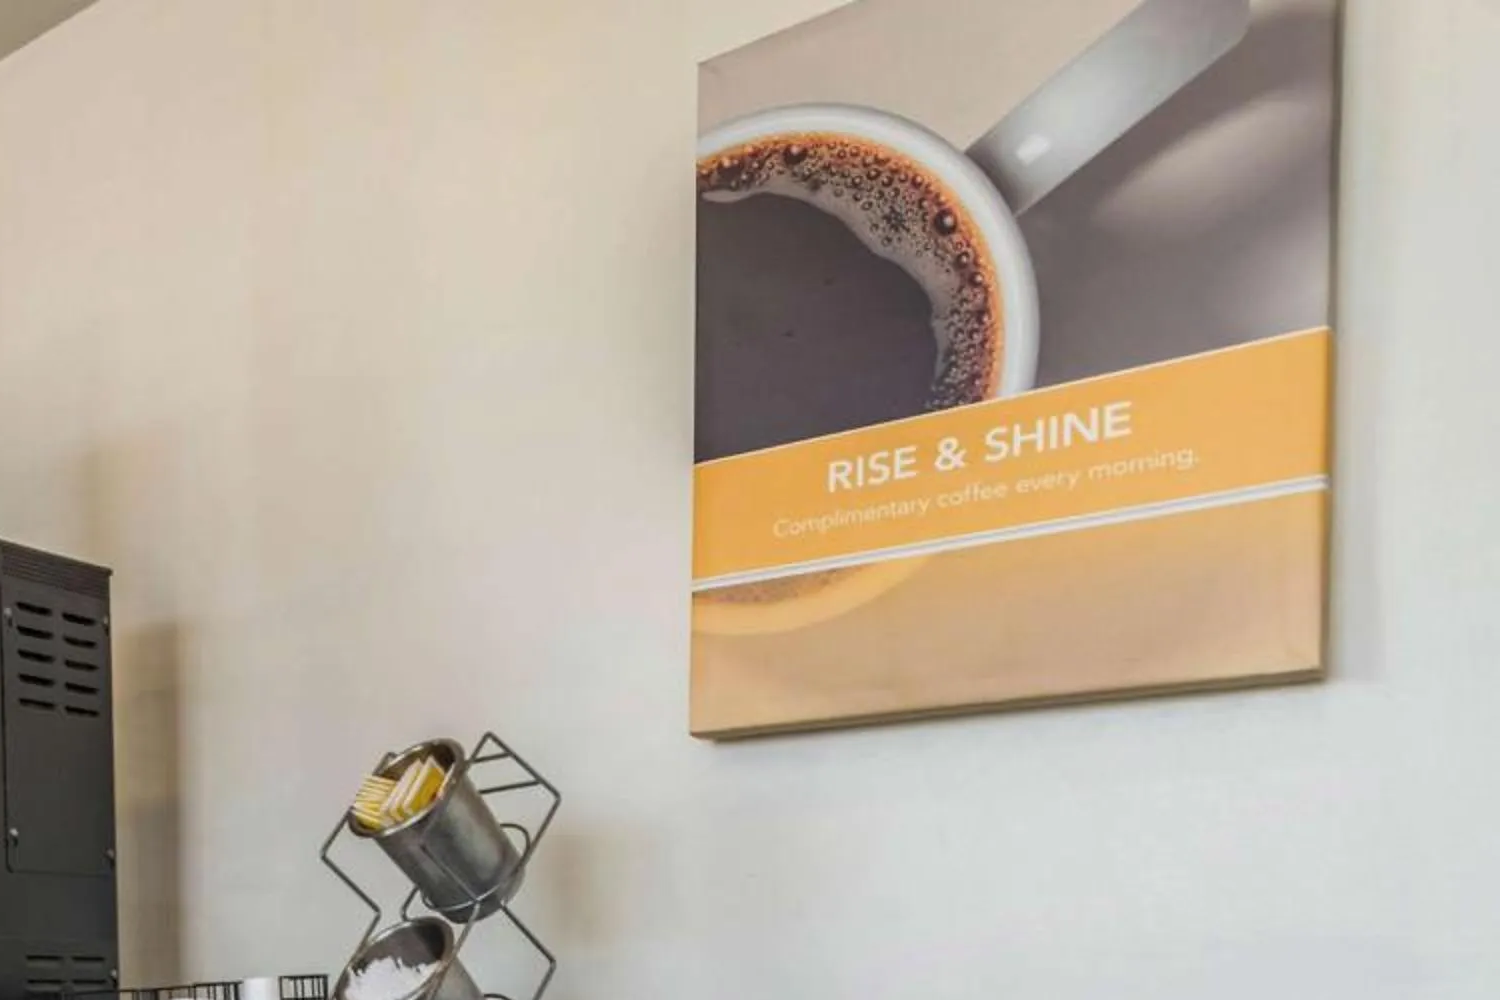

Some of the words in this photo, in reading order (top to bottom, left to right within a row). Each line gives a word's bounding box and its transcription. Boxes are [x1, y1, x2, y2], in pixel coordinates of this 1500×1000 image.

[828, 445, 918, 492] RISE
[934, 436, 968, 472] &
[985, 400, 1133, 462] SHINE
[773, 497, 931, 538] Complimentary
[937, 479, 1008, 508] coffee
[1015, 469, 1080, 493] every
[1088, 447, 1199, 480] morning.
